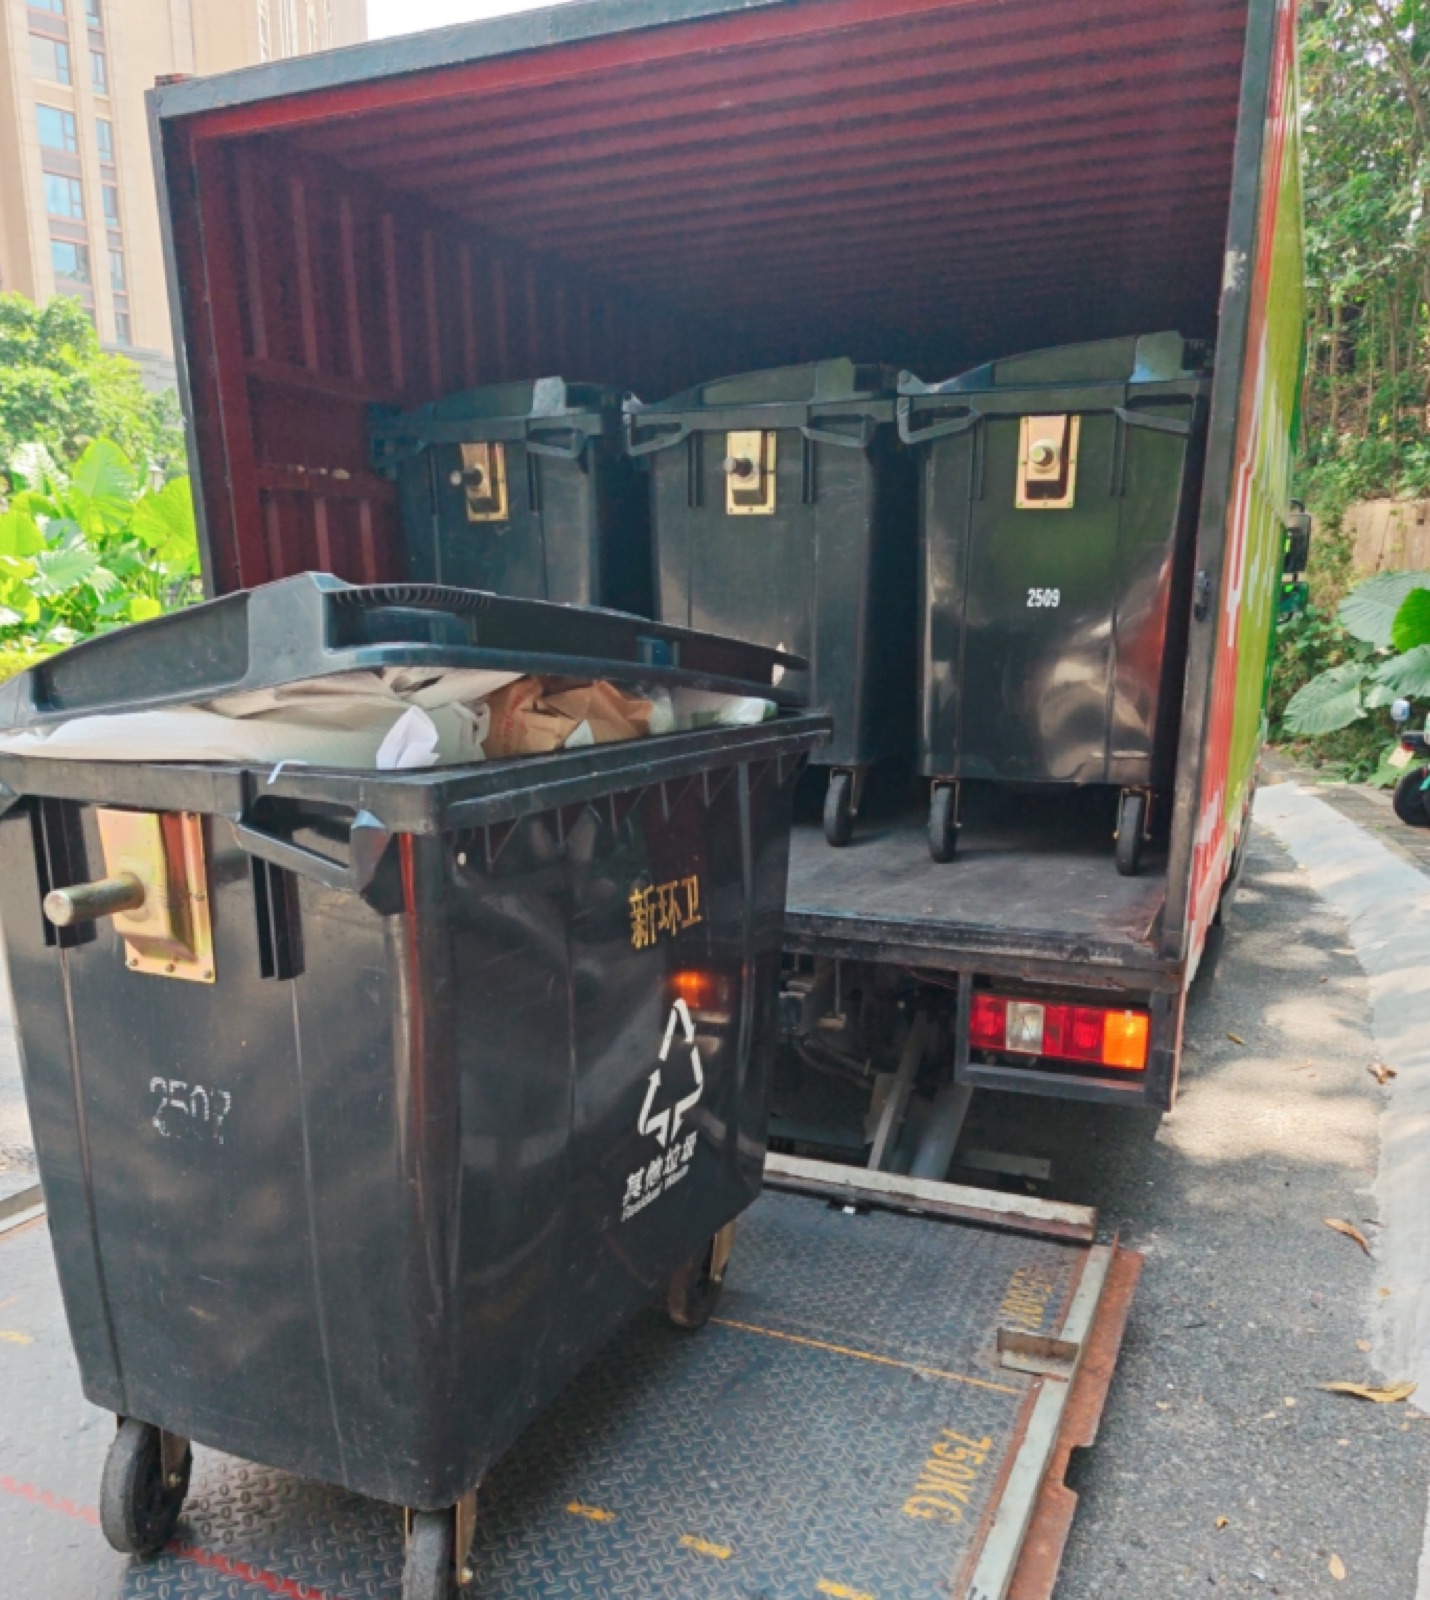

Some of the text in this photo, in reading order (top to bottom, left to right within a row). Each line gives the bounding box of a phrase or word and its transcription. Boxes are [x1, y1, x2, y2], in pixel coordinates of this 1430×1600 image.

[1026, 587, 1060, 607] 2509
[629, 873, 703, 949] 新环卫
[903, 1428, 992, 1523] 750KG
